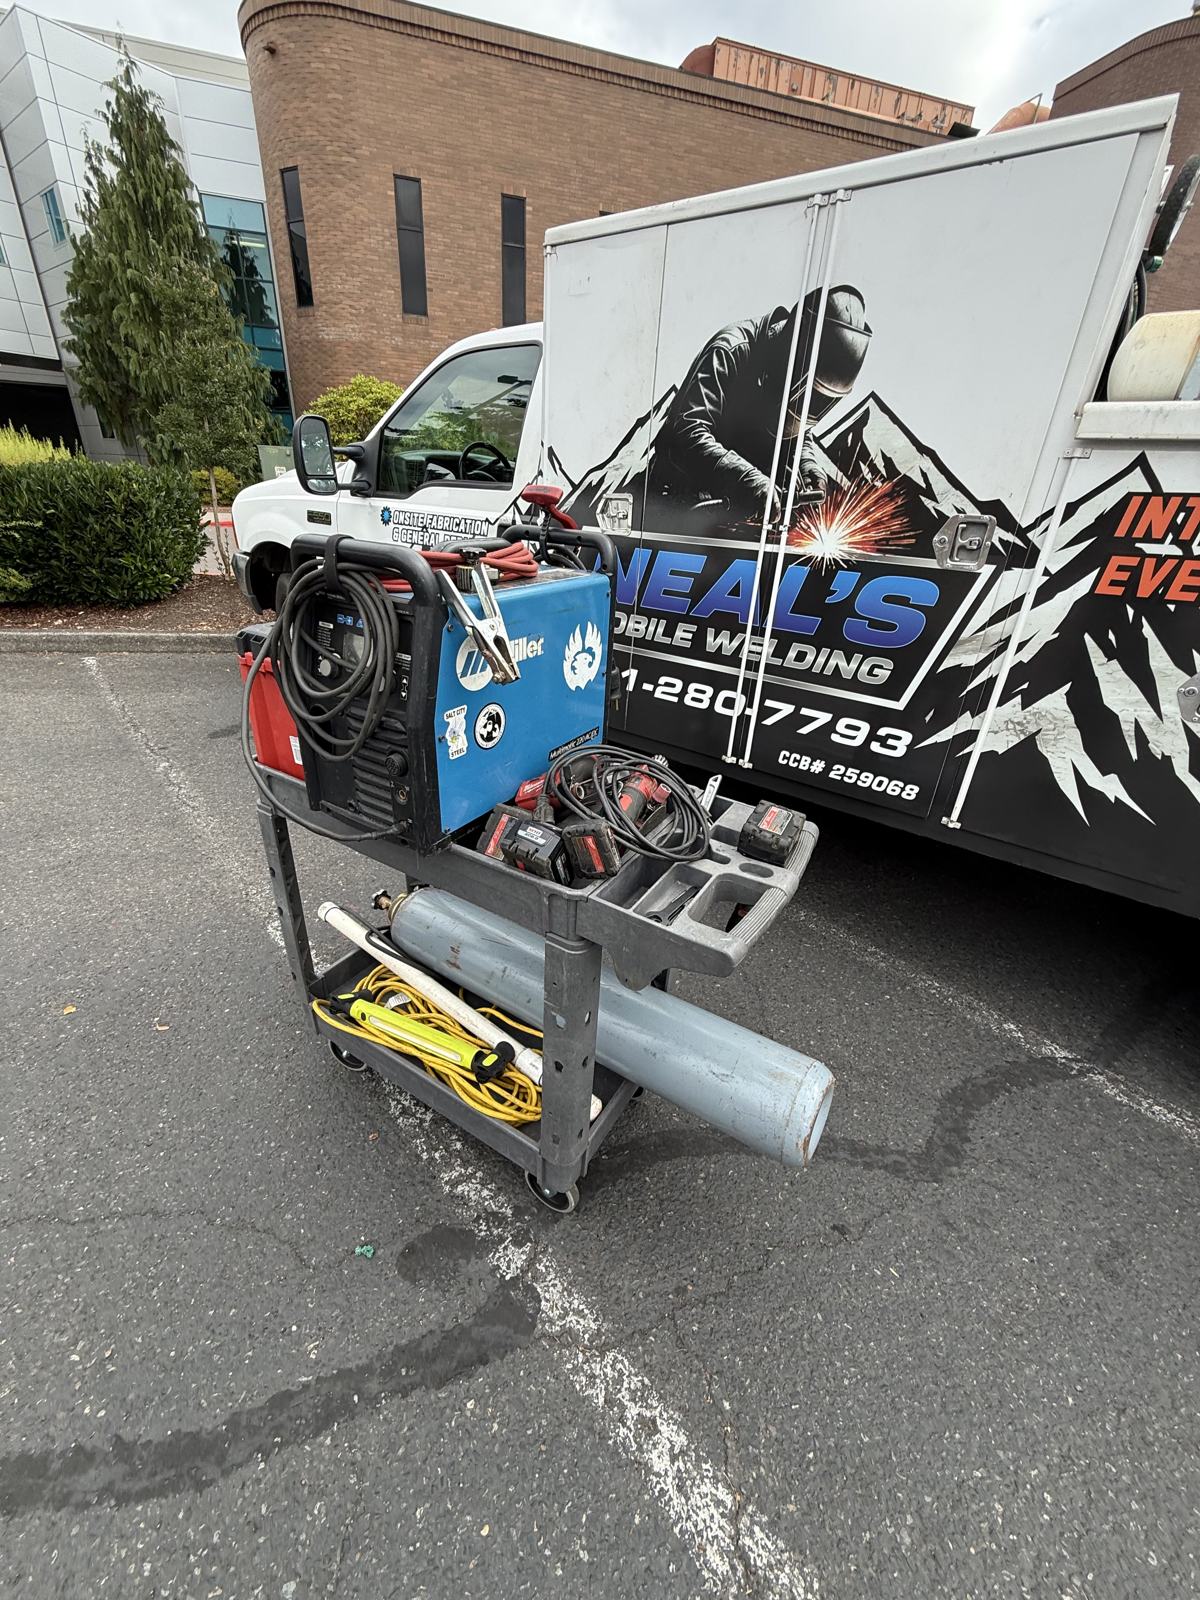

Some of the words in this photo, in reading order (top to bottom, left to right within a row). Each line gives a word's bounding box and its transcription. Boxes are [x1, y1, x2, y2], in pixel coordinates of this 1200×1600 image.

[392, 527, 400, 542] &
[393, 510, 426, 527] ONSITE
[426, 514, 489, 536] FABRICATION
[593, 545, 940, 648] NEAL'S
[509, 636, 544, 663] iller
[614, 611, 698, 648] OBILE
[706, 627, 894, 685] WELDING
[445, 711, 456, 720] SALT
[456, 707, 466, 716] CITY
[621, 668, 913, 758] 1-280-7793
[450, 747, 465, 758] STEEL
[778, 750, 826, 774] CCB#
[828, 764, 920, 801] 259068
